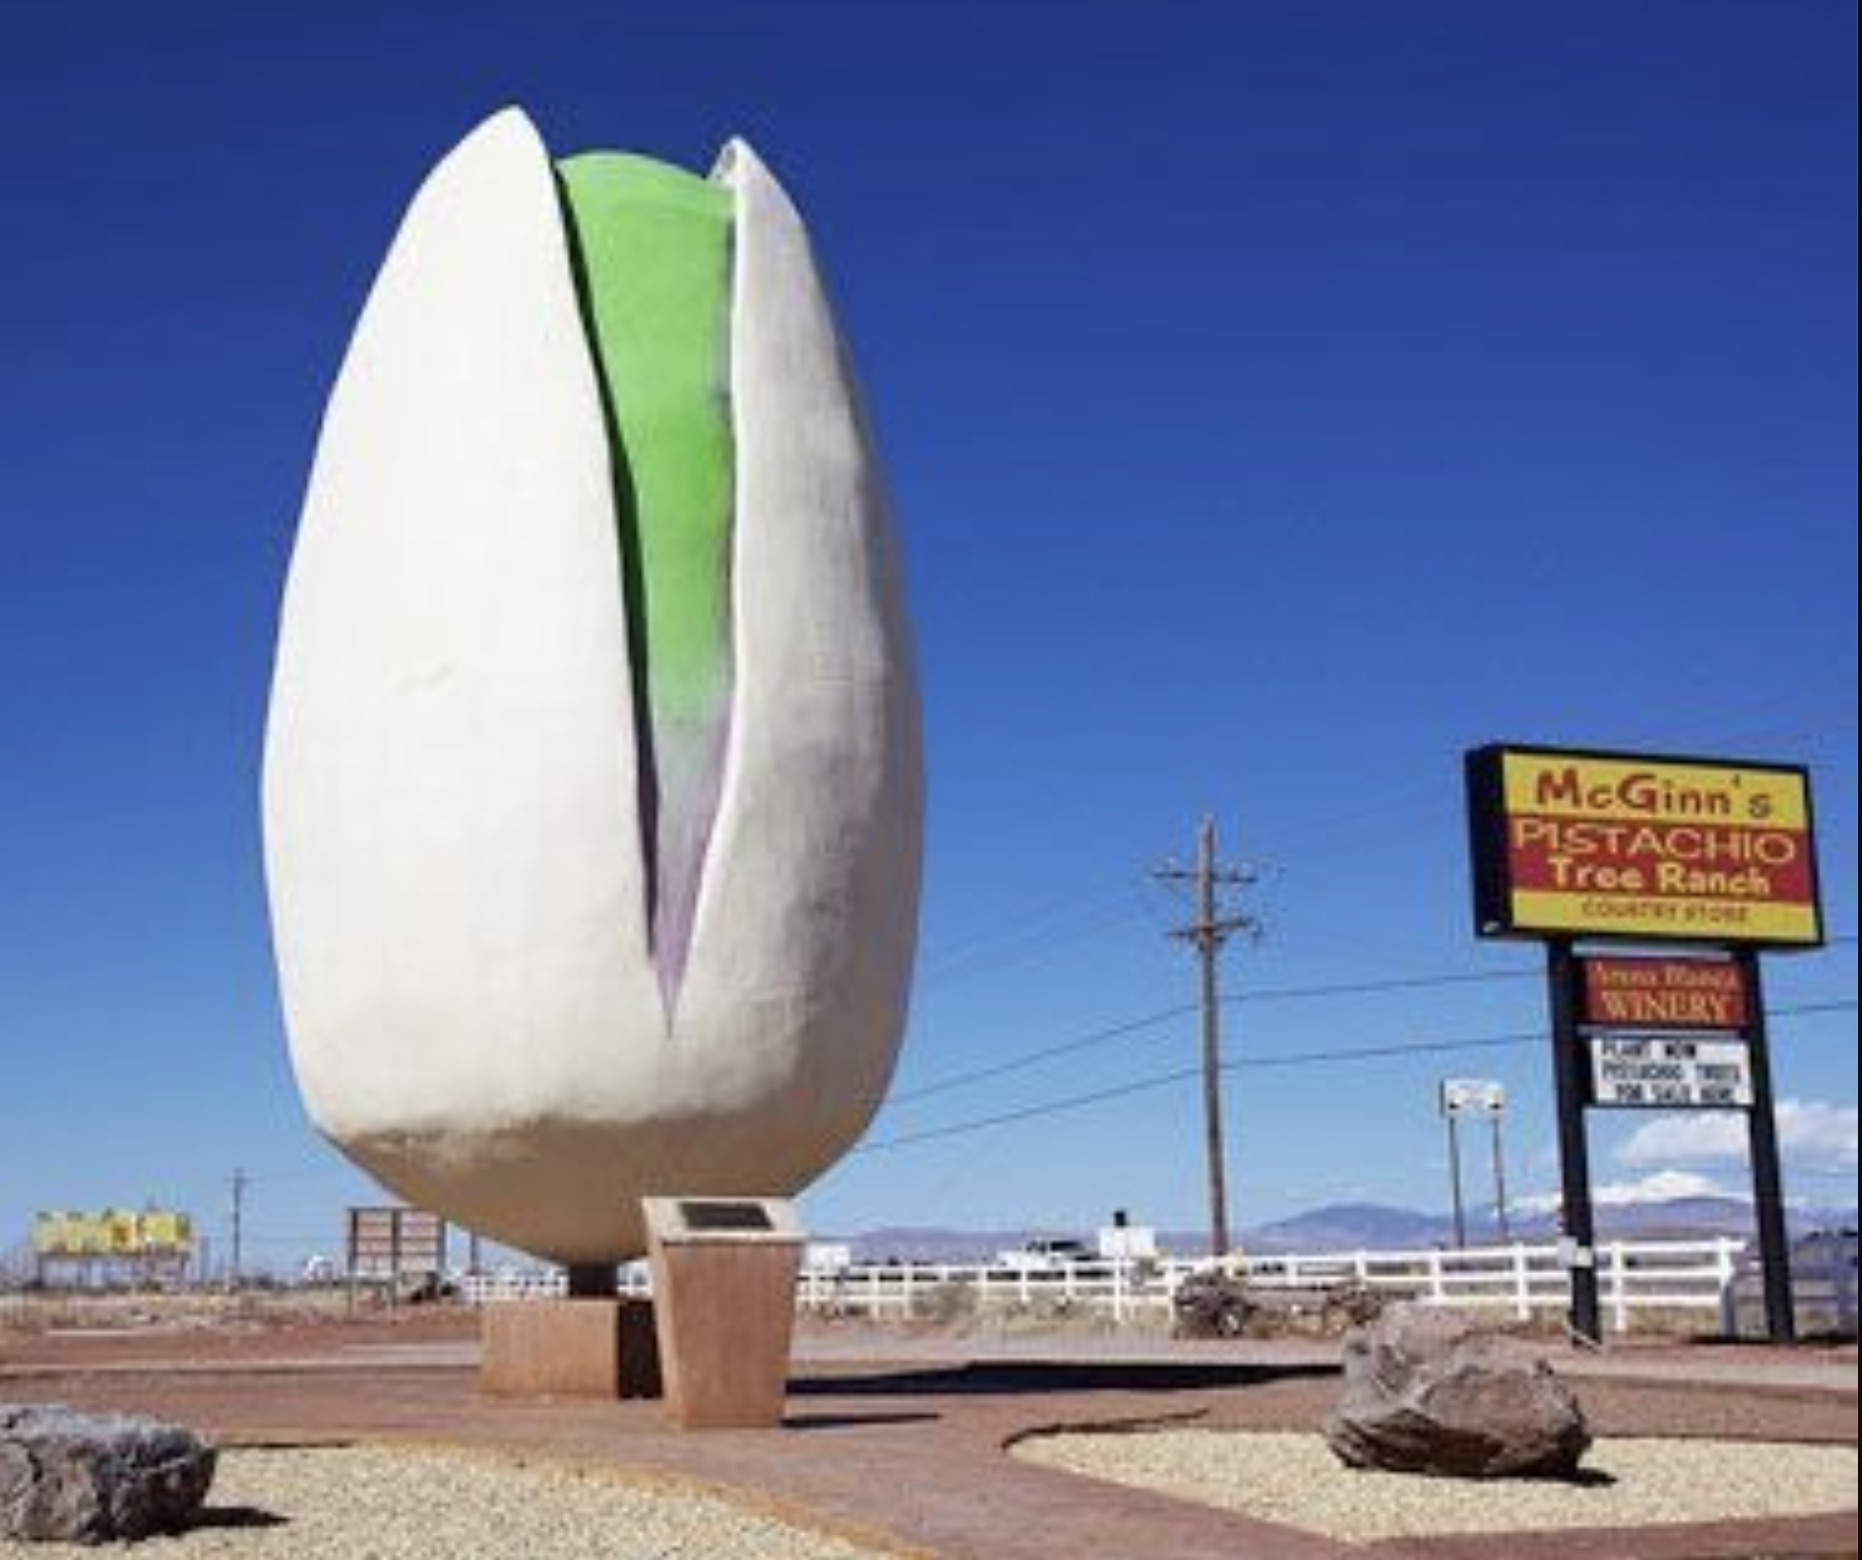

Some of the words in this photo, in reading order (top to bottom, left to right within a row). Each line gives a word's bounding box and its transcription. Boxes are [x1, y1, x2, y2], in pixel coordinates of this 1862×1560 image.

[1537, 768, 1771, 819] McGinn's
[1516, 817, 1796, 865] PISTACHIO
[1548, 856, 1643, 889] Tree
[1656, 861, 1771, 895] Ranch
[1600, 989, 1731, 1025] WINERY
